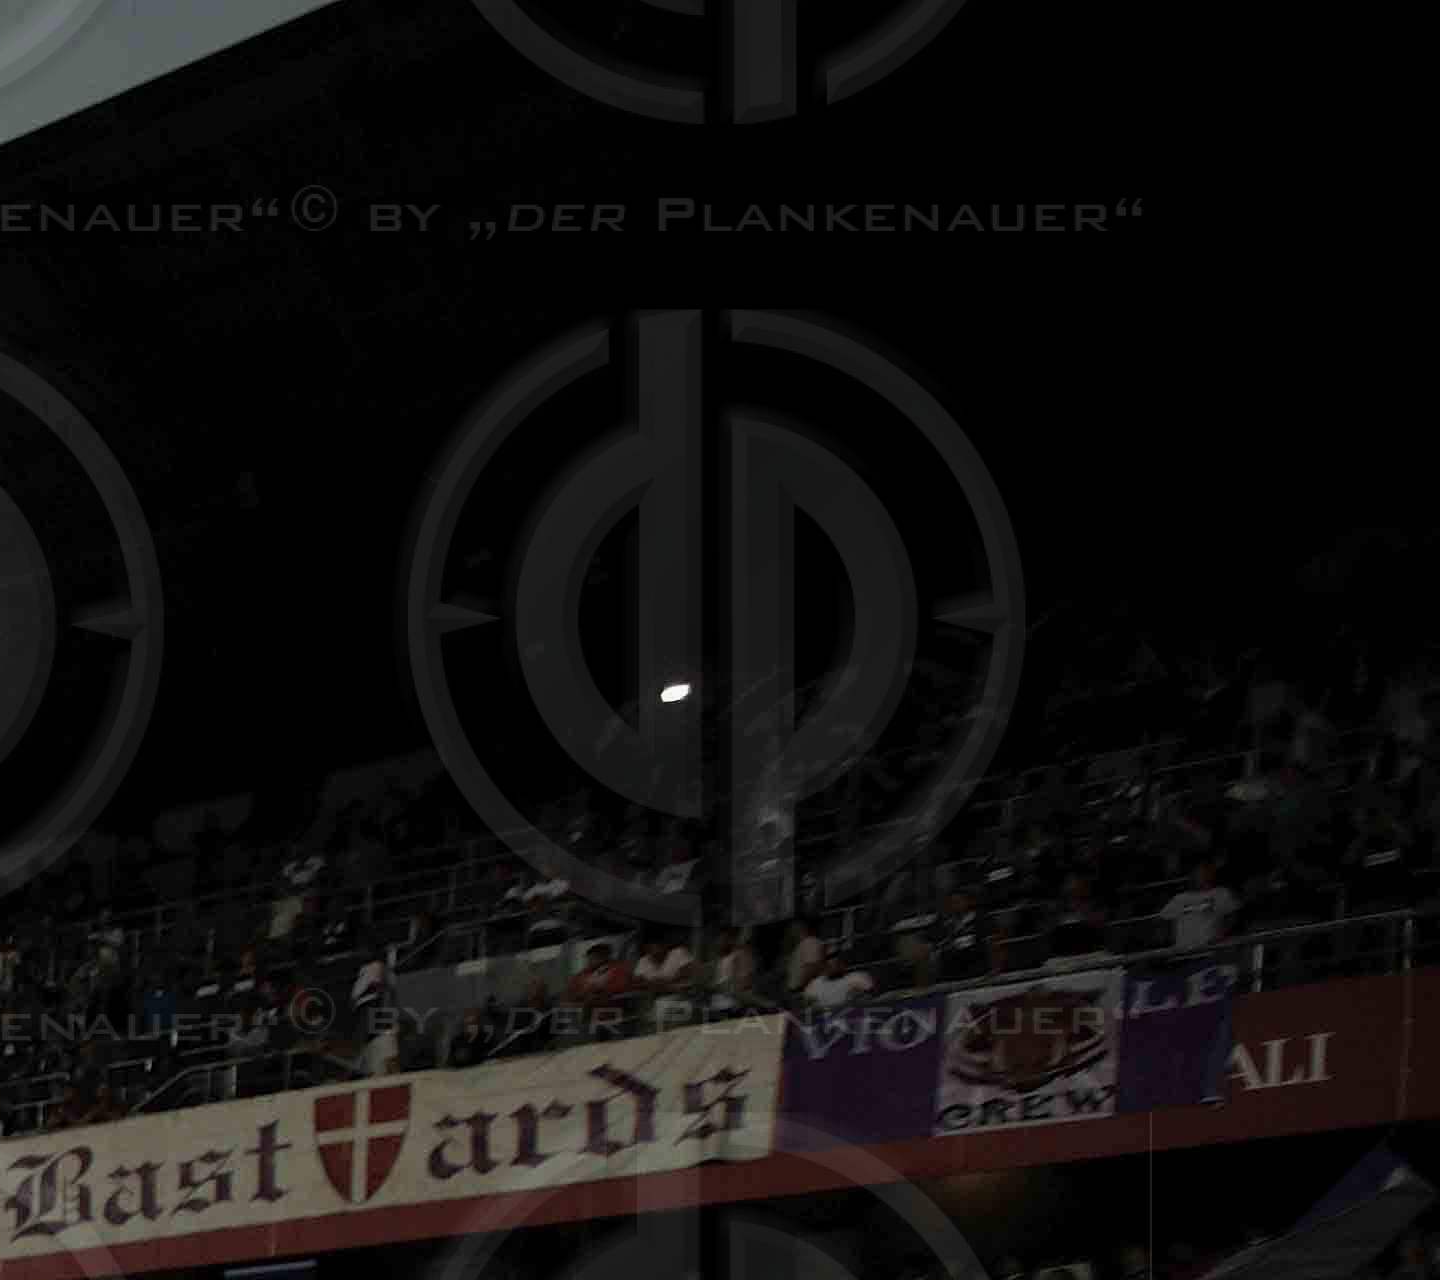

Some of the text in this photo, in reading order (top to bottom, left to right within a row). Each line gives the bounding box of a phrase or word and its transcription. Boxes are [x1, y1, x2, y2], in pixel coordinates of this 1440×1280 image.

[3, 1063, 752, 1241] Bast ards
[938, 1084, 1120, 1132] CREW
